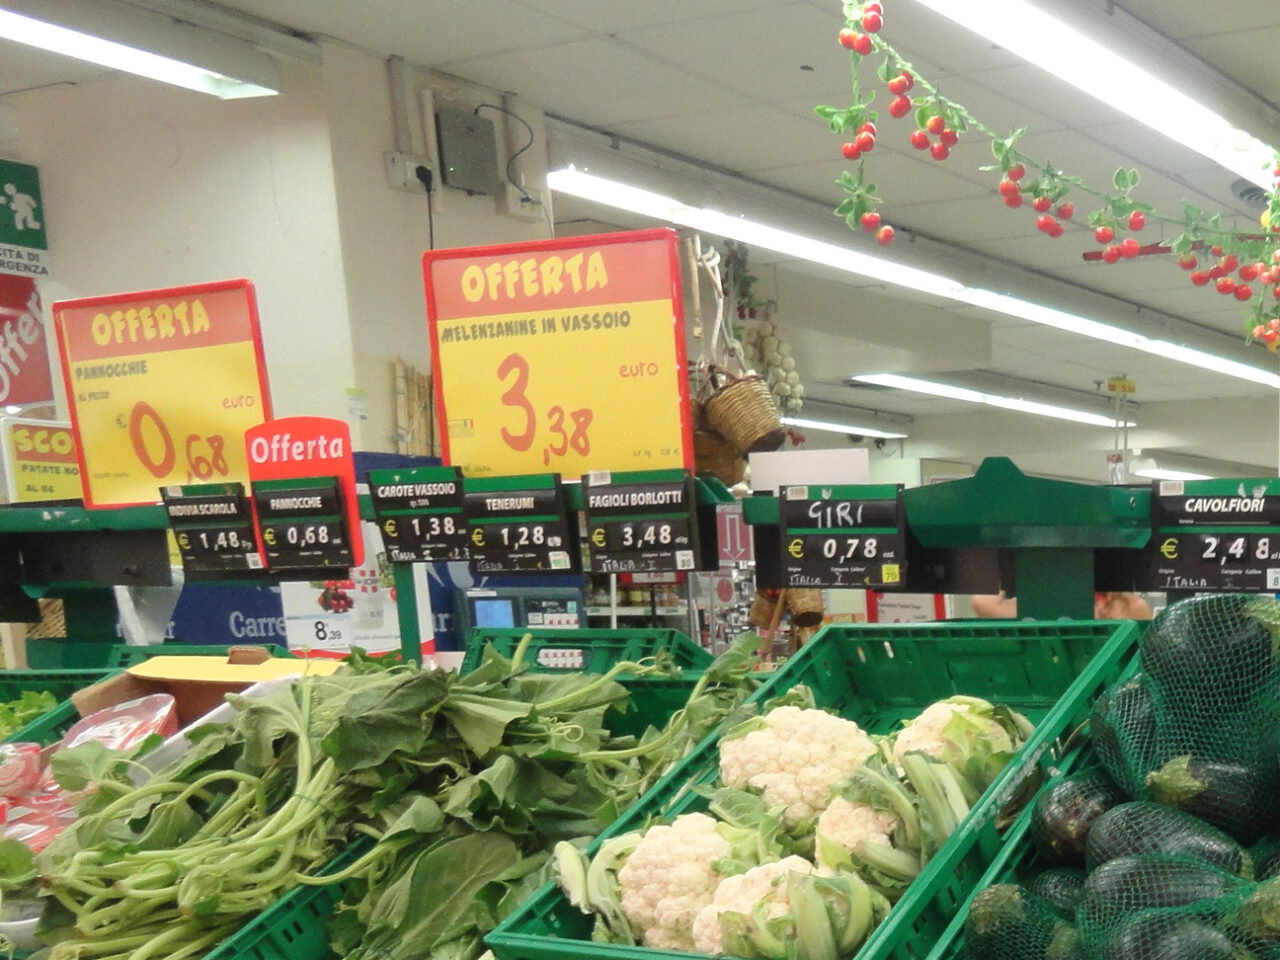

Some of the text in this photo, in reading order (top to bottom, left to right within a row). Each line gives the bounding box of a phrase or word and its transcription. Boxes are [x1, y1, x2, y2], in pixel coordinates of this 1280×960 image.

[27, 252, 40, 262] DI
[460, 251, 609, 303] OFFERTA
[91, 299, 211, 347] OFFERTA
[441, 310, 632, 343] MELENZANINE IN VASSOIO
[75, 360, 148, 382] PANNOCCHIE
[619, 361, 659, 378] euro
[222, 395, 255, 409] euro
[496, 352, 594, 467] 3,38
[15, 428, 73, 455] SCO
[115, 400, 230, 485] € 0,68
[251, 433, 344, 464] Offerta
[377, 482, 456, 498] CAROTE VASSOIO
[589, 490, 682, 508] FAGIOLI BORLOTTI
[270, 496, 323, 511] PANNOCCHIE
[485, 497, 535, 511] TENERUMI
[808, 500, 864, 529] GIRI
[1184, 498, 1265, 513] CAVOLFIORI
[263, 528, 277, 545] €
[287, 525, 329, 548] 0,68
[384, 516, 456, 541] € 1,38
[471, 528, 486, 547] €
[501, 525, 545, 551] 1,28
[592, 524, 672, 548] € 3,48
[178, 533, 192, 549] €
[199, 531, 240, 551] 1,48
[788, 538, 804, 559] €
[823, 538, 878, 564] 0,78
[1160, 537, 1179, 559] €
[1202, 536, 1270, 566] 2,48
[885, 571, 897, 581] 70
